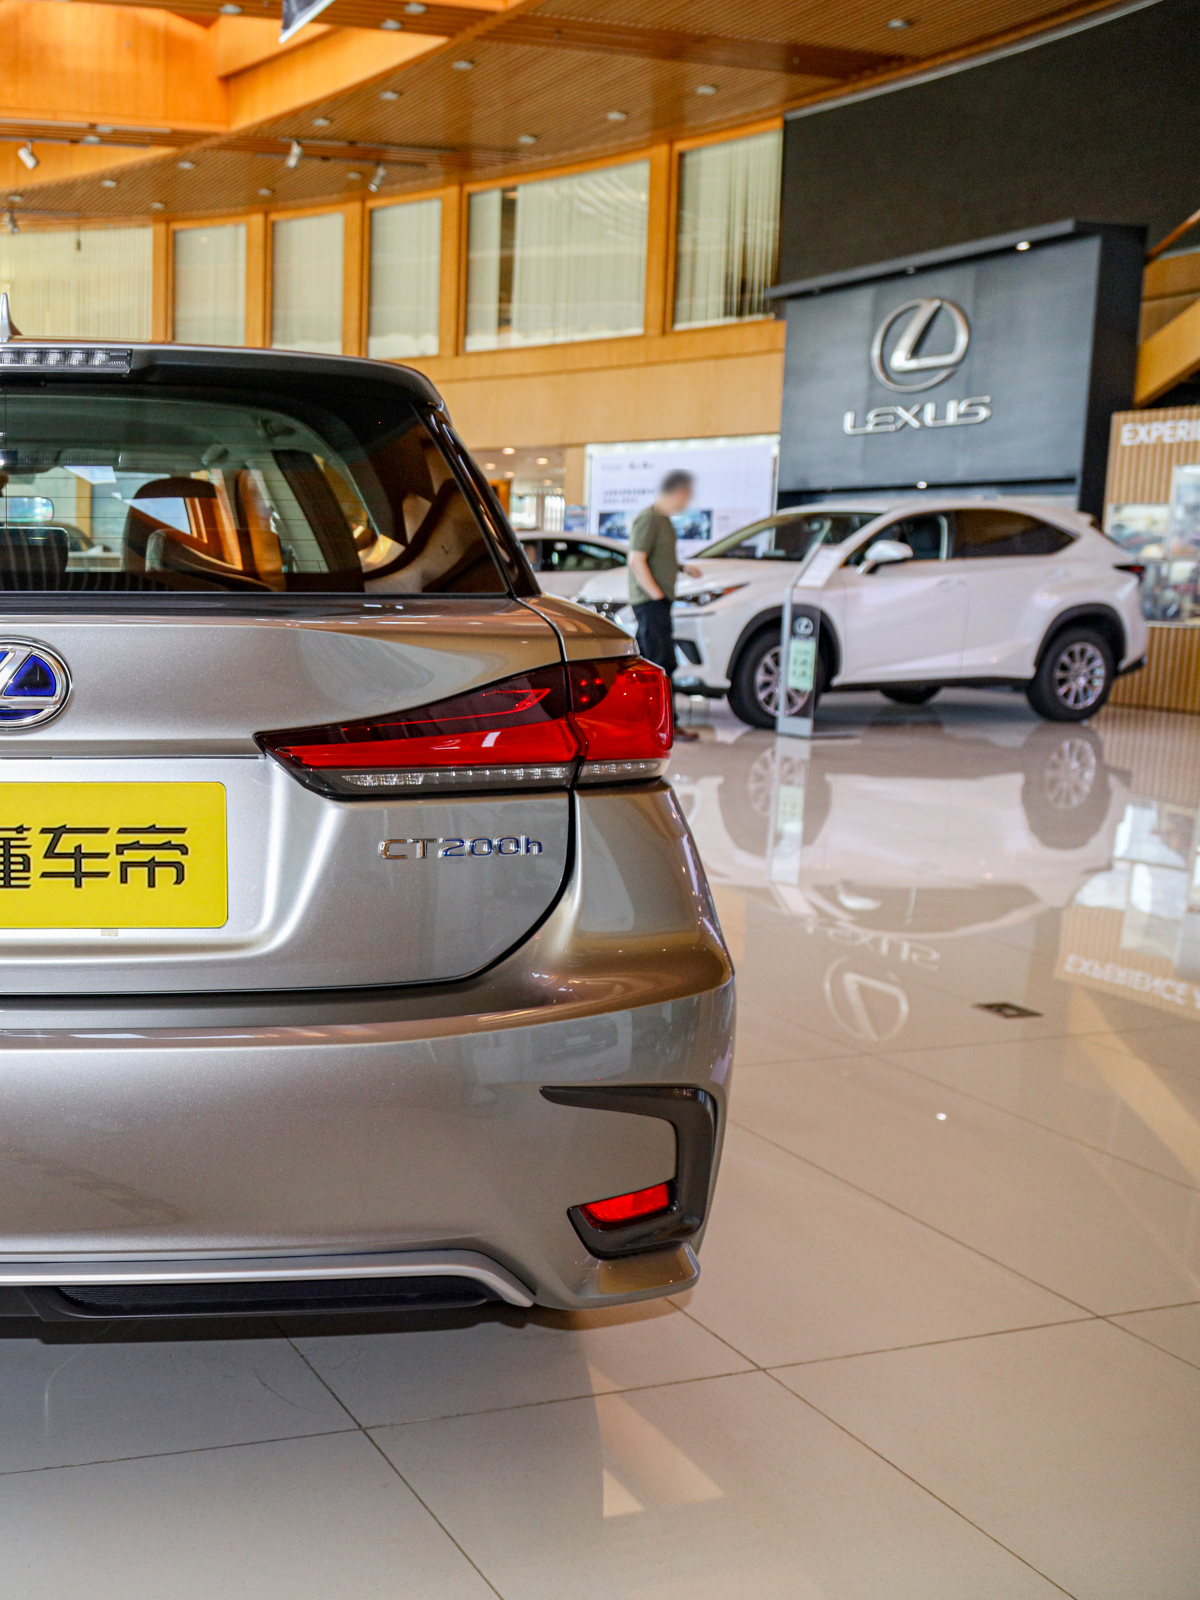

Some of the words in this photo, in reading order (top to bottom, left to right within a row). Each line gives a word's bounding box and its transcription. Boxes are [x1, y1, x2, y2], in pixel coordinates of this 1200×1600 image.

[843, 395, 992, 435] LEXUS
[1121, 419, 1200, 446] EXPERI
[377, 834, 543, 860] CT200h
